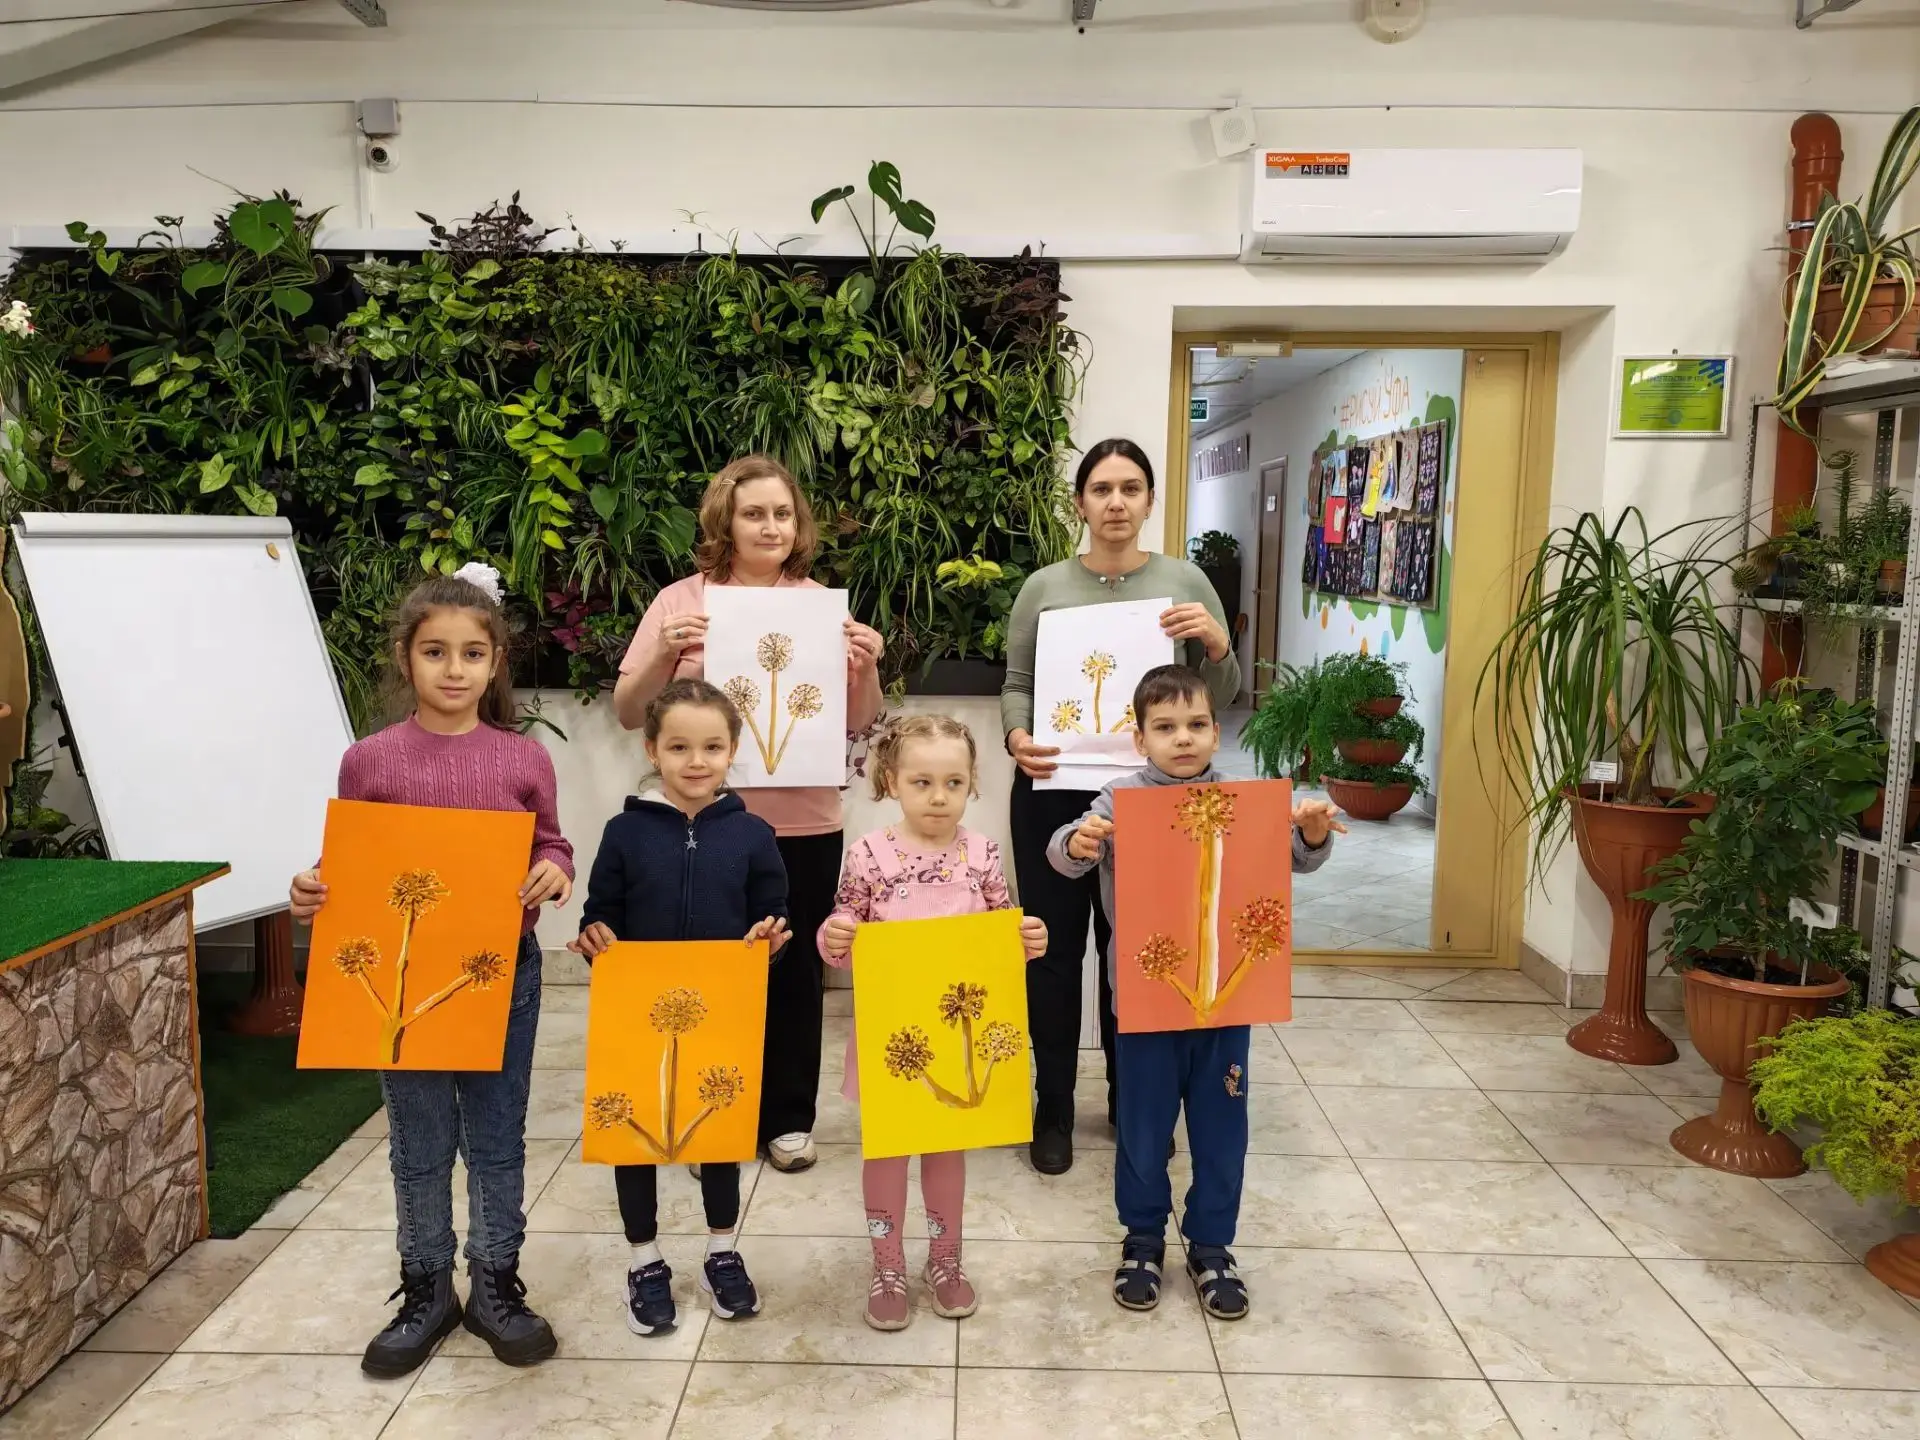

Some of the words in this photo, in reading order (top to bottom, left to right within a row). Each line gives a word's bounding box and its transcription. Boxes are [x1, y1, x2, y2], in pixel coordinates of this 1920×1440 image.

[1268, 155, 1296, 163] XIGMA
[1316, 155, 1349, 163] TurboCool
[1191, 402, 1207, 410] ХОД
